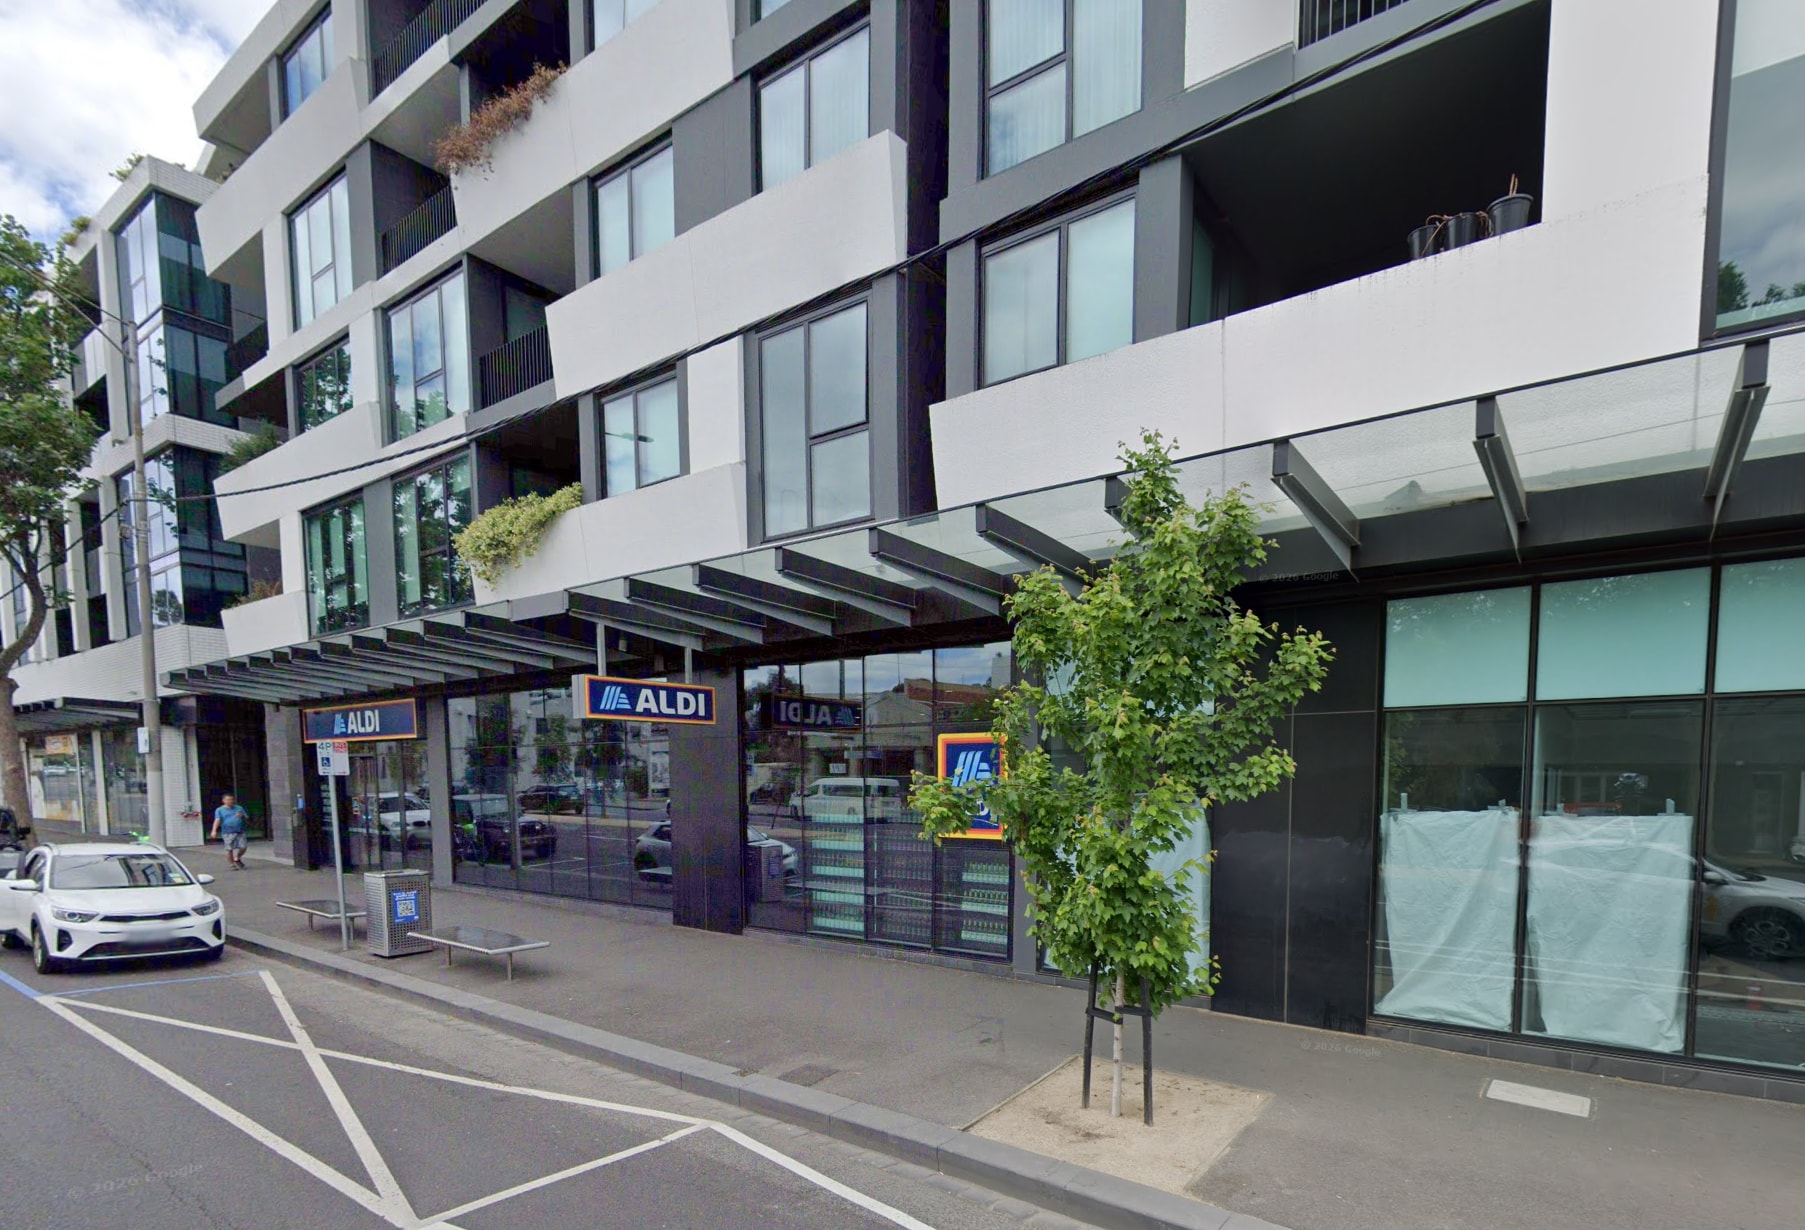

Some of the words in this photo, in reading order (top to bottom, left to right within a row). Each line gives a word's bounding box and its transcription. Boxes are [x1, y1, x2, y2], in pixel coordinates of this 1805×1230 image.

[636, 688, 706, 716] ALDI
[347, 709, 380, 734] ALDI
[318, 742, 332, 751] 4P
